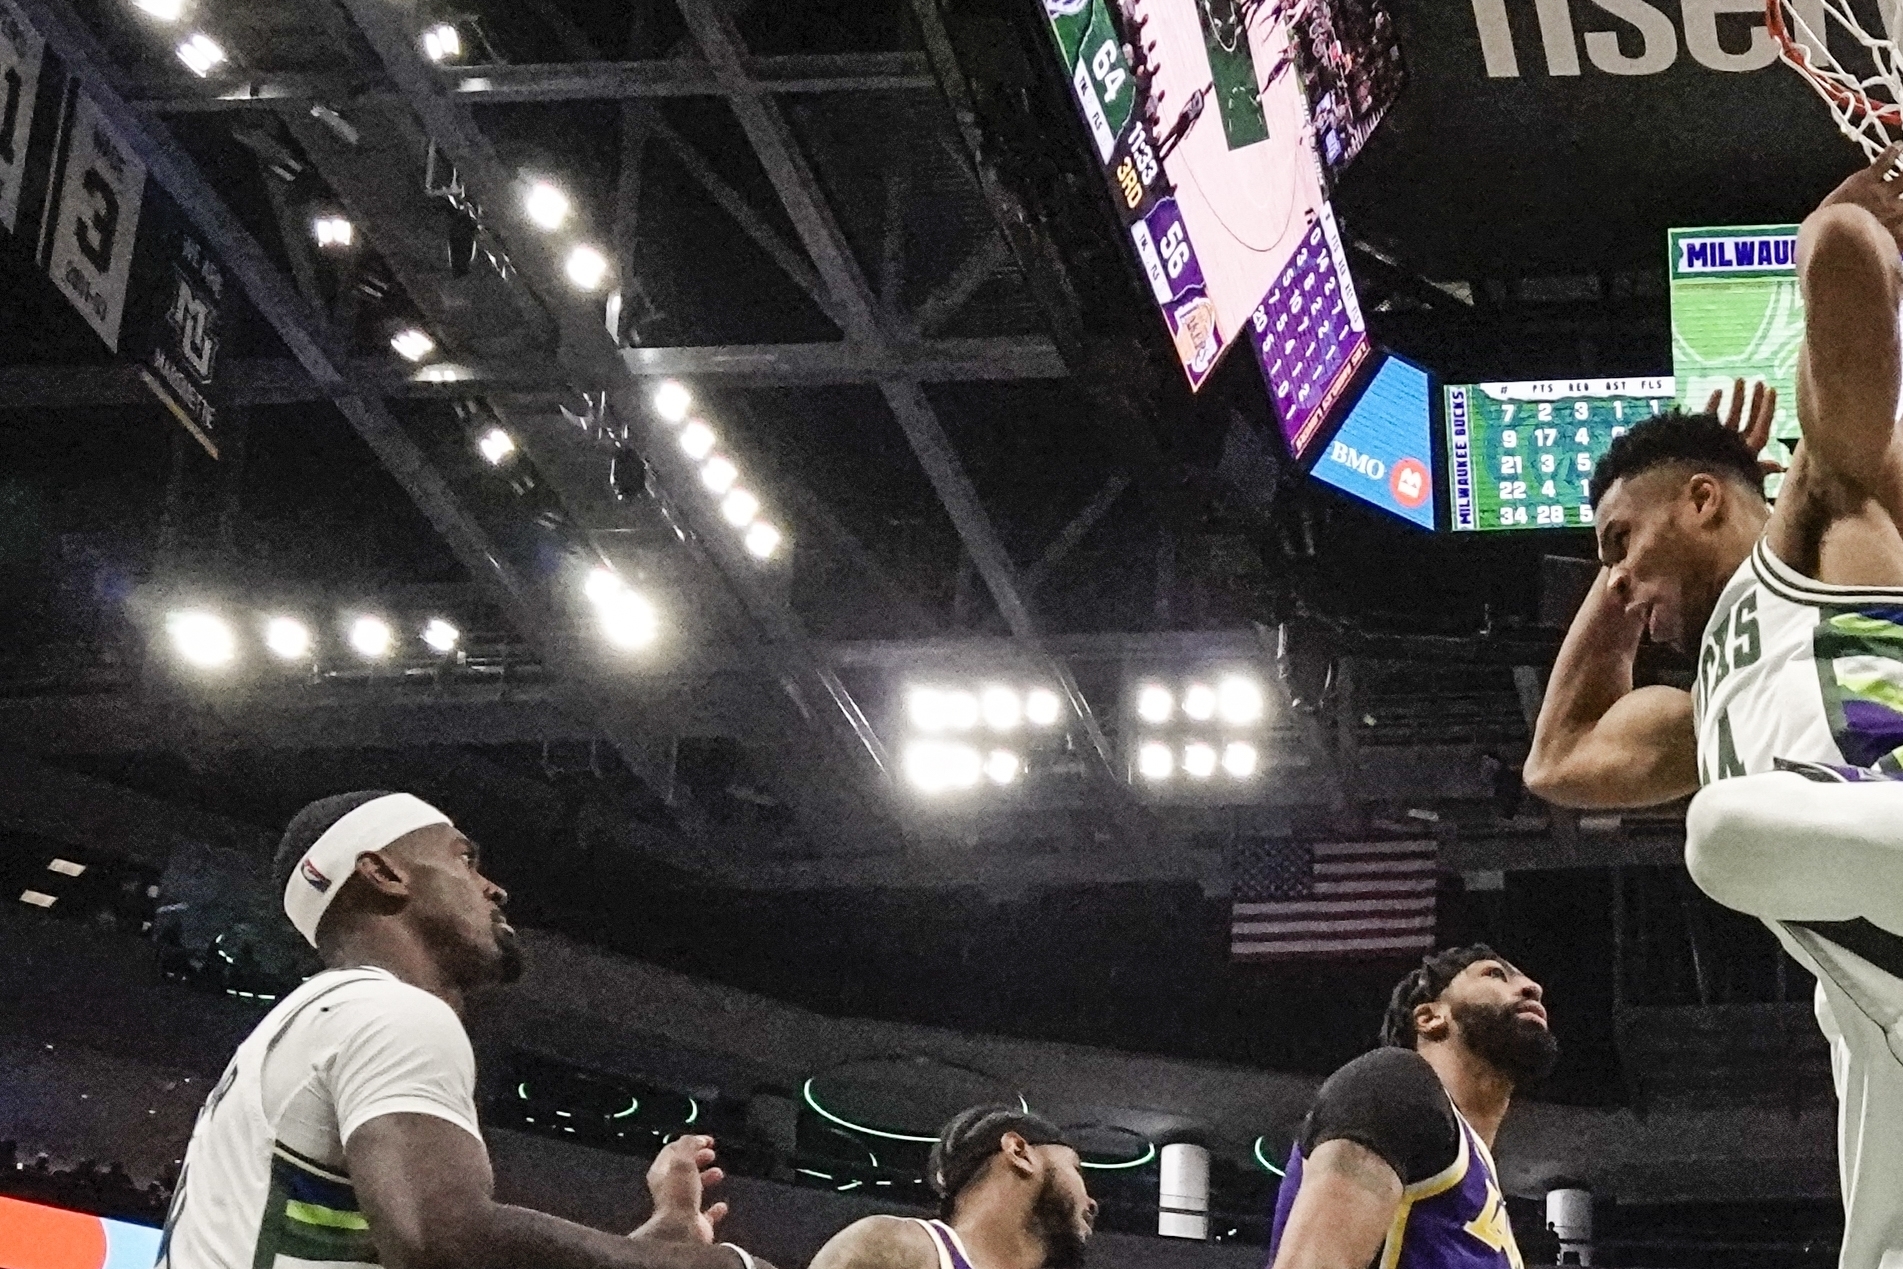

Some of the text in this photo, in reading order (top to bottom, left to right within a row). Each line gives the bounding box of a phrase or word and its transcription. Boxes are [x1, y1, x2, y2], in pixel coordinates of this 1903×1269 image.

[1093, 39, 1126, 103] 64
[1128, 121, 1158, 186] 11:33
[1116, 156, 1144, 208] 3RD
[1159, 220, 1190, 279] 56
[1533, 384, 1553, 393] PTS
[1642, 380, 1662, 389] FLS
[1502, 400, 1659, 422] 7 2 3 1 1
[1503, 427, 1589, 448] 9 17 4
[1330, 440, 1385, 481] BMO
[1452, 391, 1472, 524] MILWAUKEE BUCKS
[1502, 453, 1591, 474] 21 3 5
[1500, 479, 1589, 499] 22 4 1
[1500, 505, 1593, 524] 34 28 5
